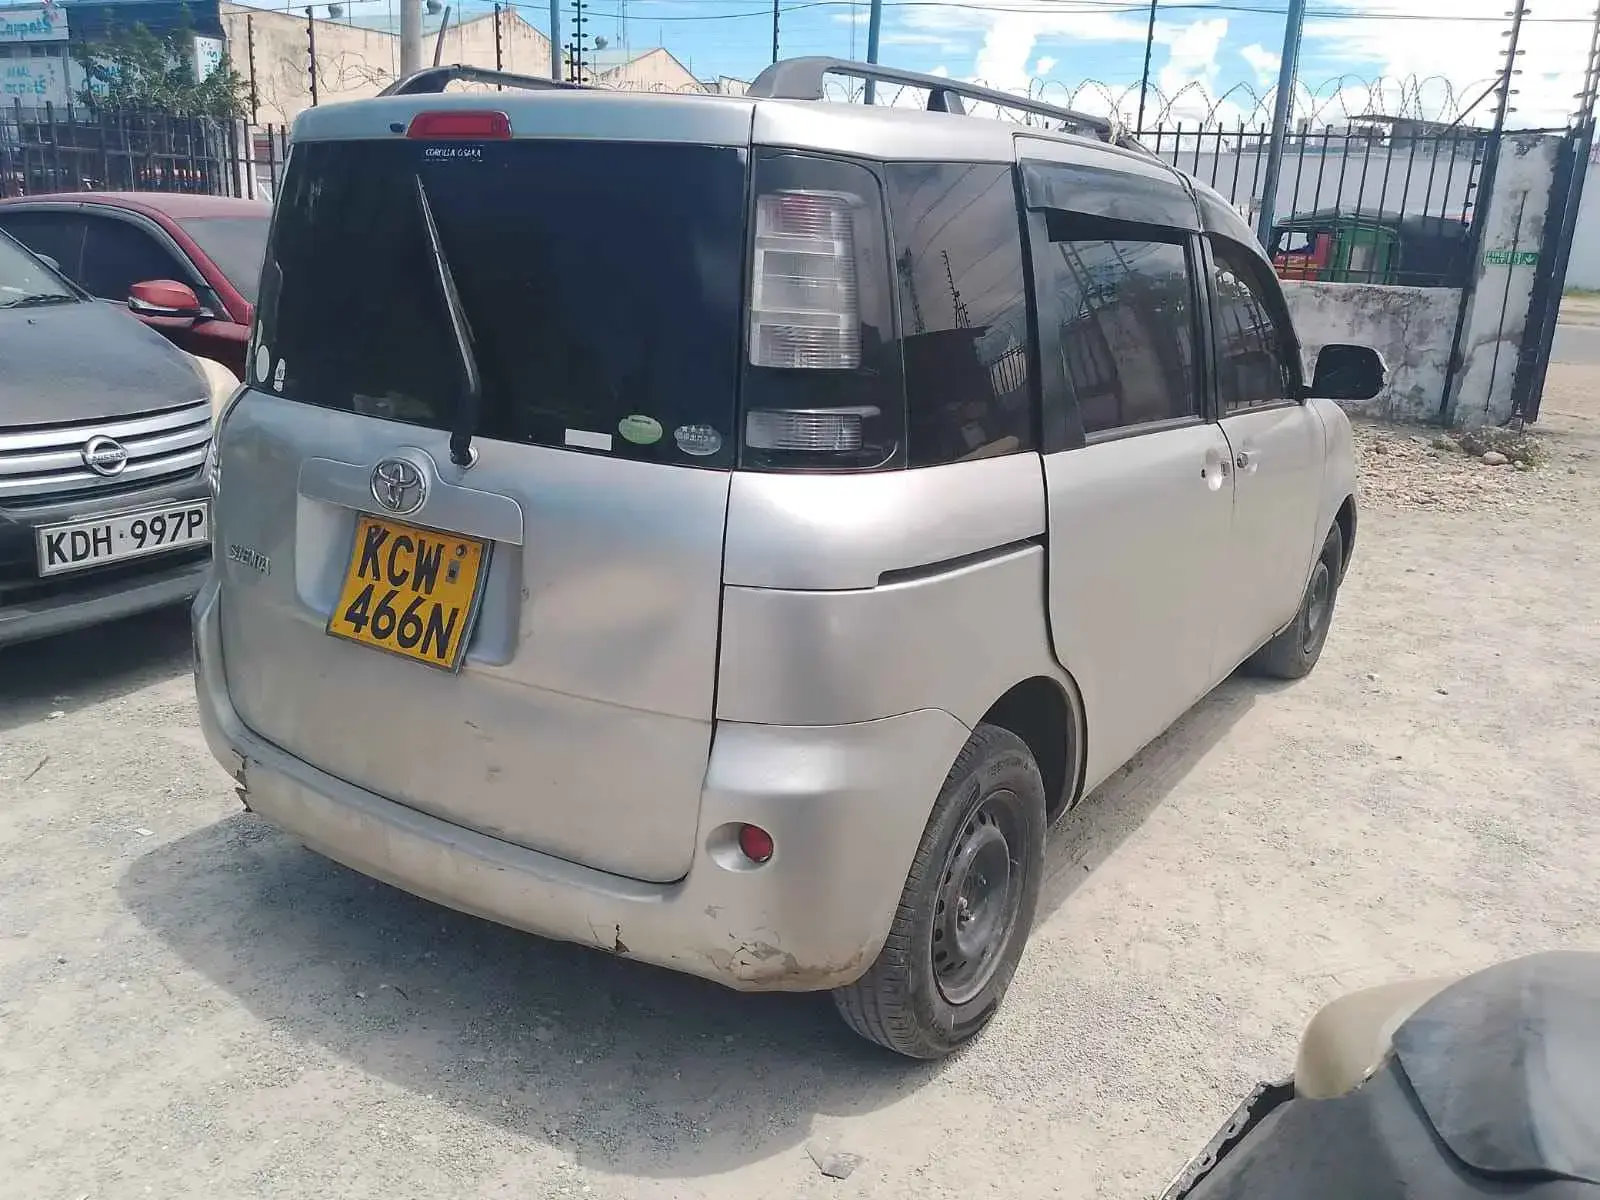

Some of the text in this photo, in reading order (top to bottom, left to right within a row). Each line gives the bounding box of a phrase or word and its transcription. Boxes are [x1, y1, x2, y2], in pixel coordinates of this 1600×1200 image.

[92, 451, 127, 462] NISSAN
[46, 509, 204, 566] KDH 997P
[358, 525, 444, 595] KCW
[344, 584, 459, 659] 466N
